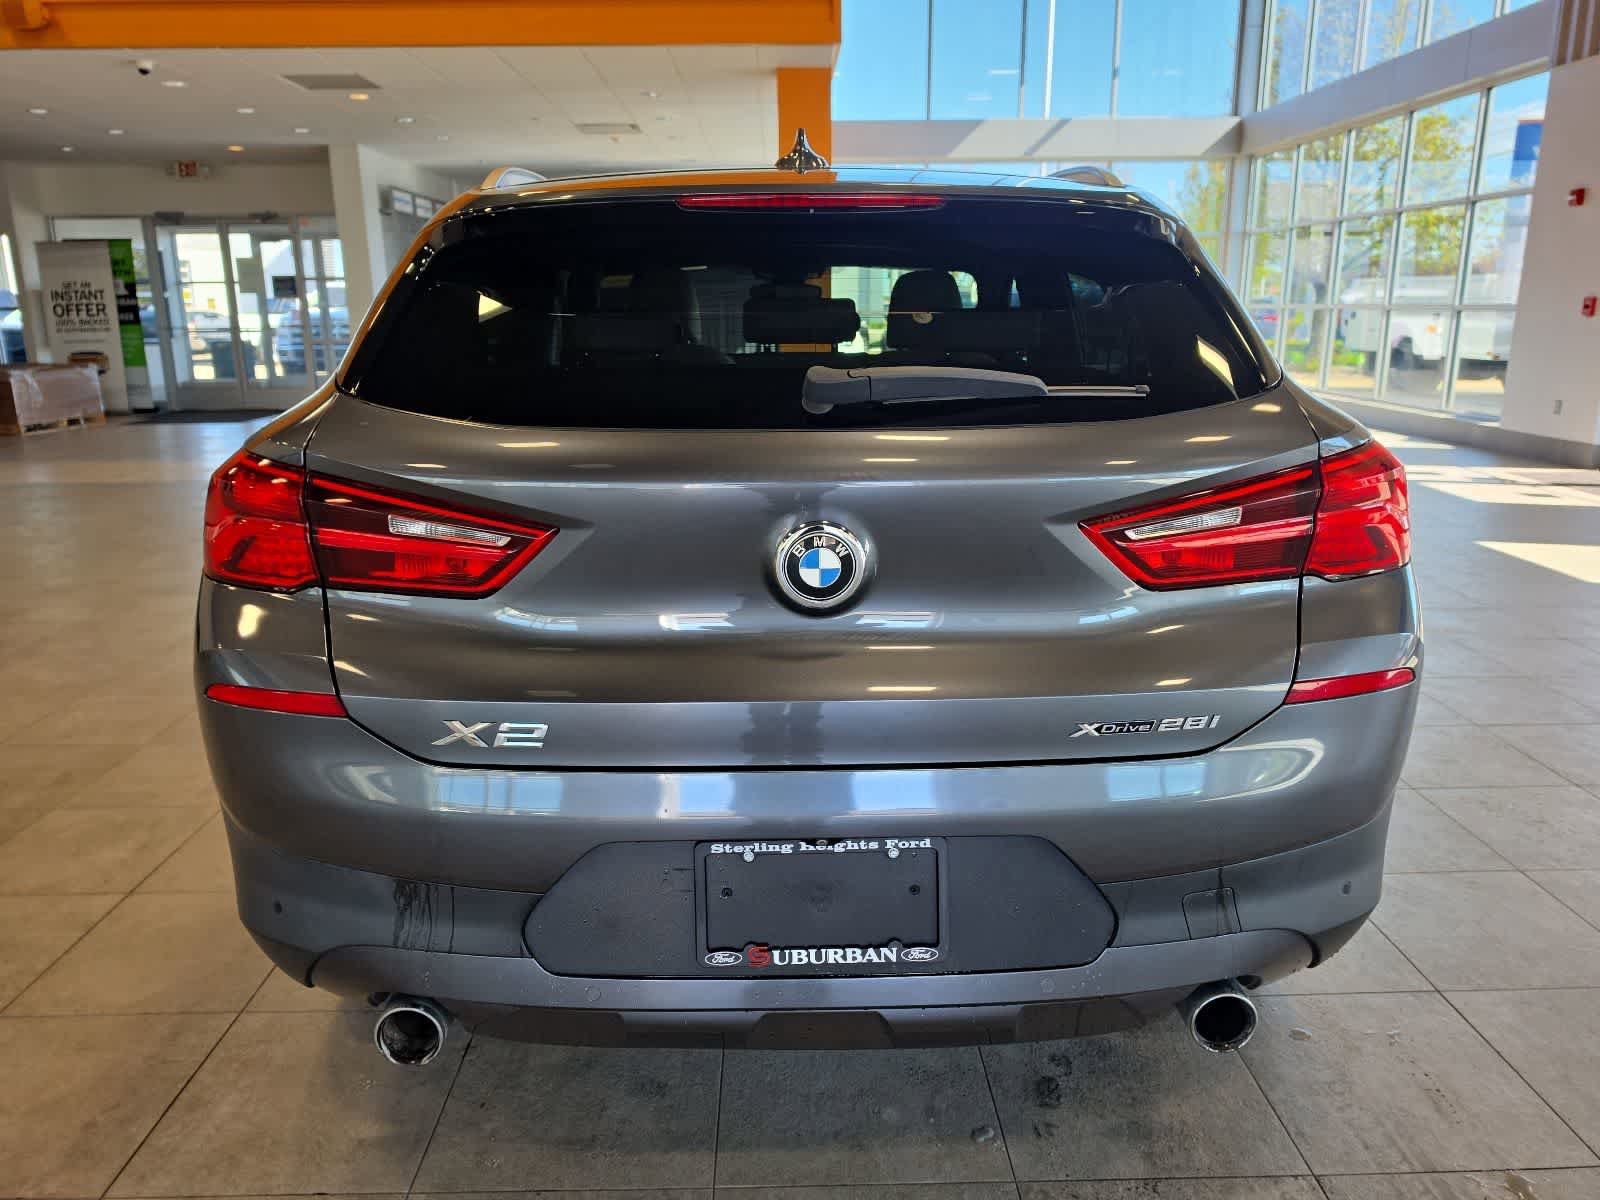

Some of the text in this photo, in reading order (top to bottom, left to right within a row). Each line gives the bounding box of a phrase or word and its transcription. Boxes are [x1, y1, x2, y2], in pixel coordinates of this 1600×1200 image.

[50, 289, 105, 302] INSTANT
[52, 303, 108, 318] OFFER
[791, 536, 850, 557] BMW
[428, 719, 549, 749] X2
[710, 842, 794, 854] Sterling
[884, 838, 932, 850] Ford
[747, 946, 898, 969] SUBURBAN
